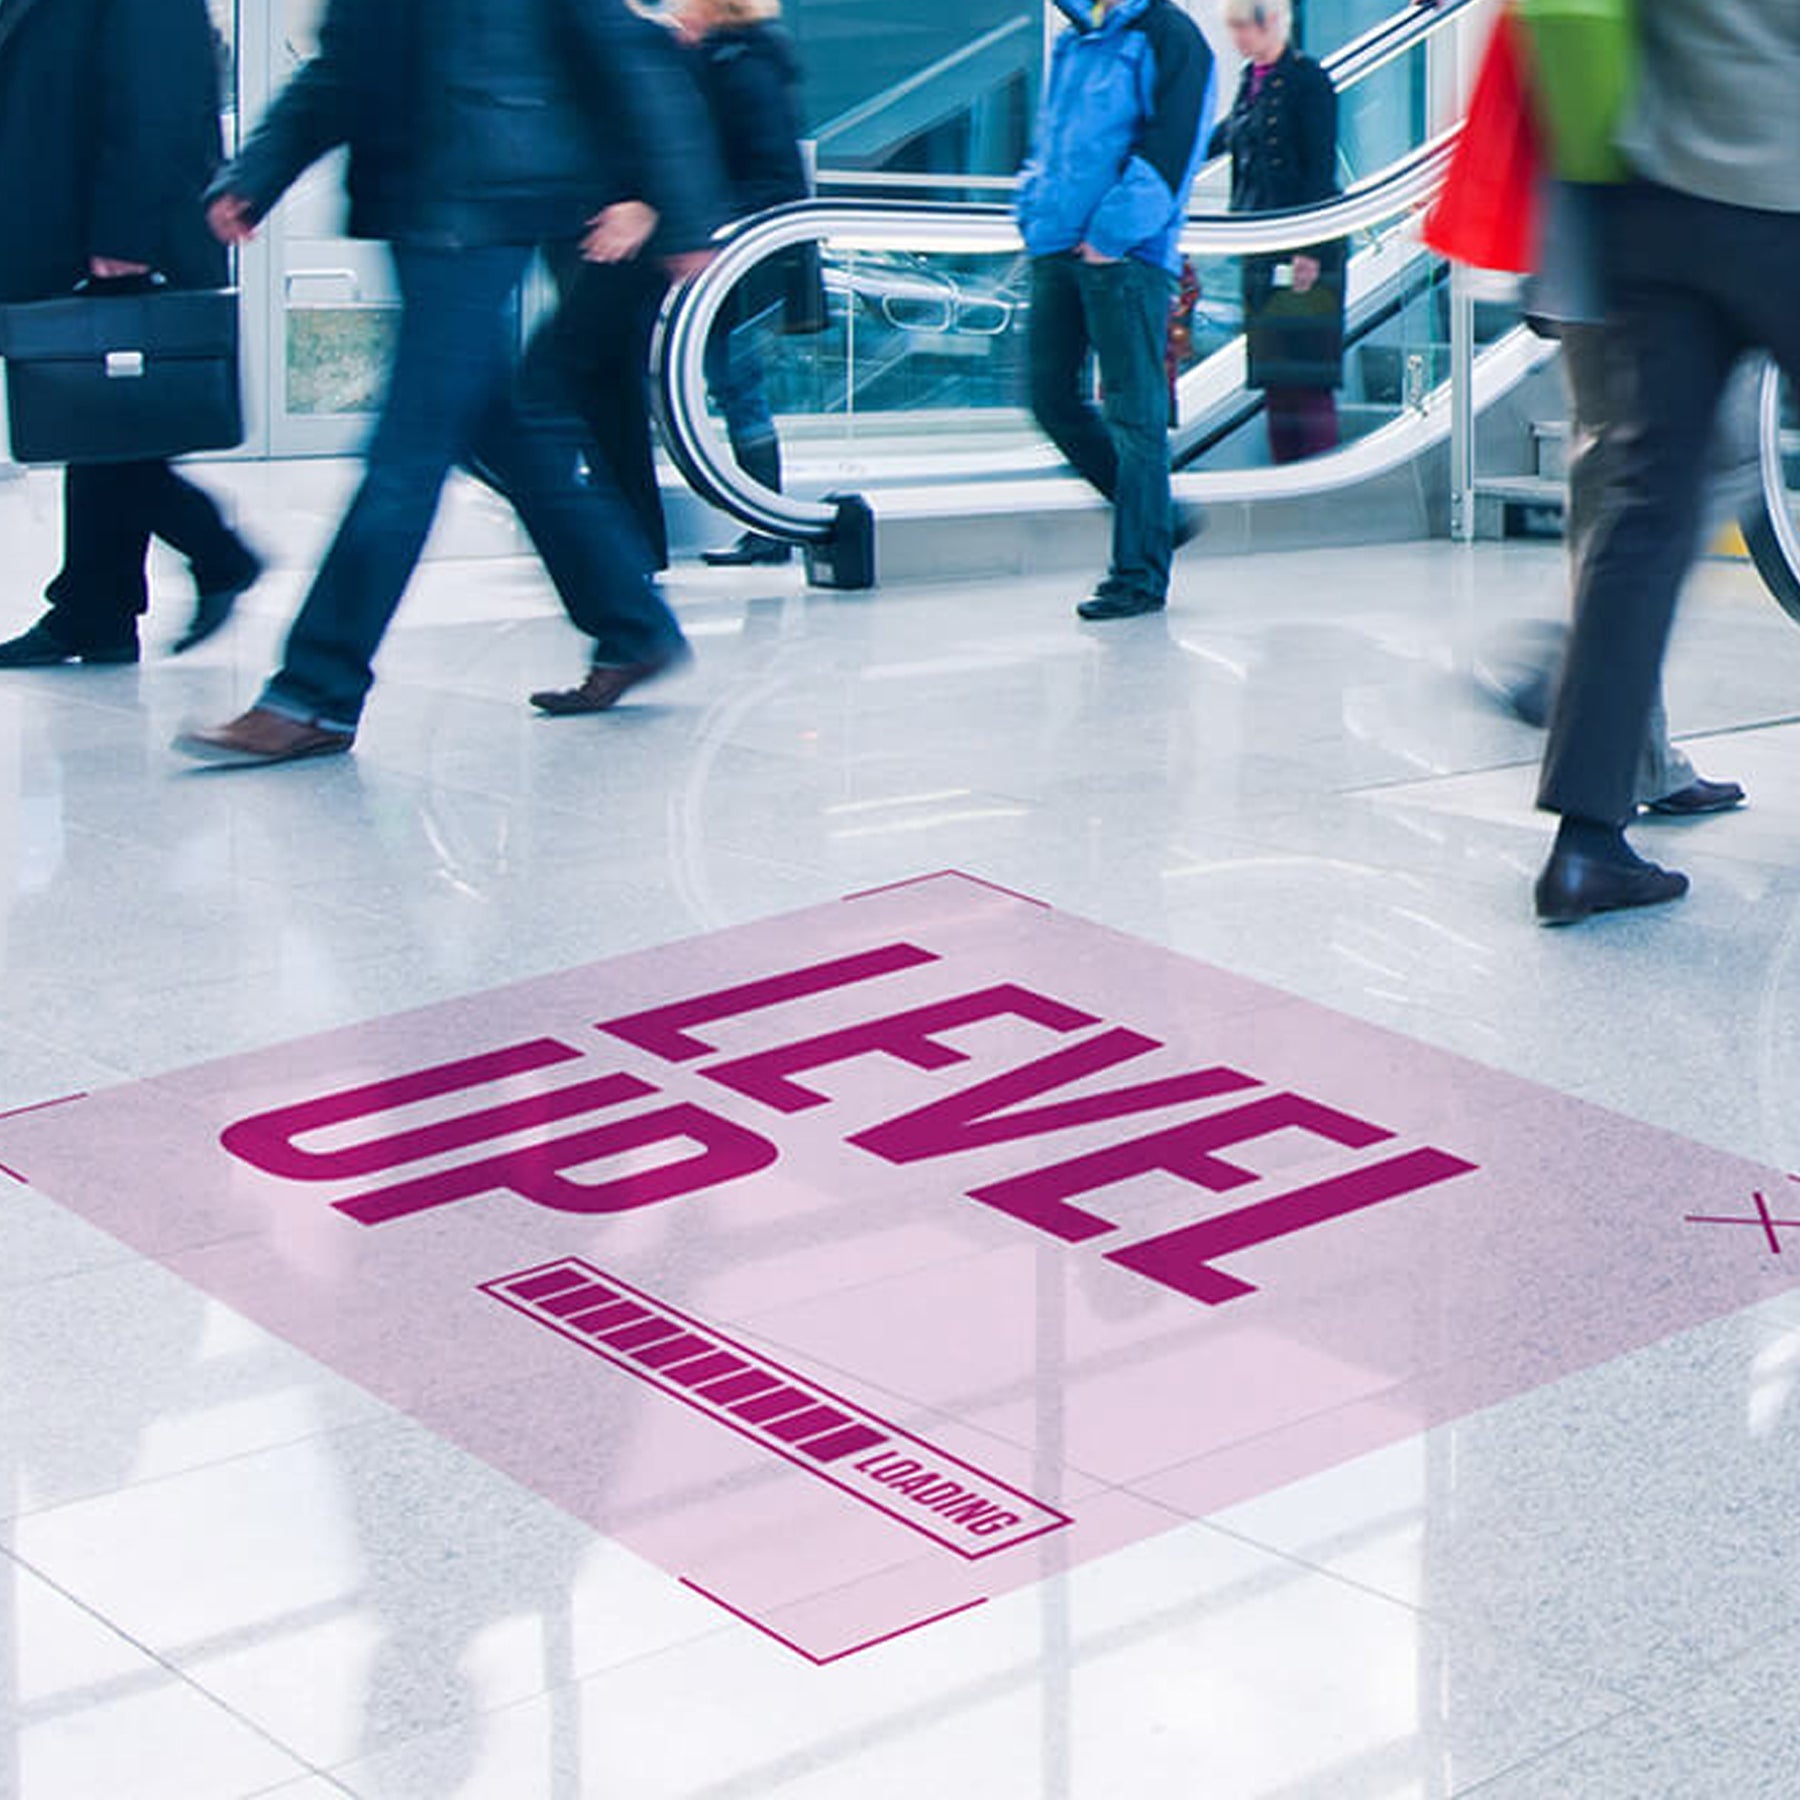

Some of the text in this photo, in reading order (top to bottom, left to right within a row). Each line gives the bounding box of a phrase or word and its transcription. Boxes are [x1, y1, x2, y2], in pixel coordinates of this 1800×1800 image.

[219, 1037, 778, 1226] UP
[597, 942, 1478, 1306] LEVEL
[853, 1450, 1021, 1536] LOADING
